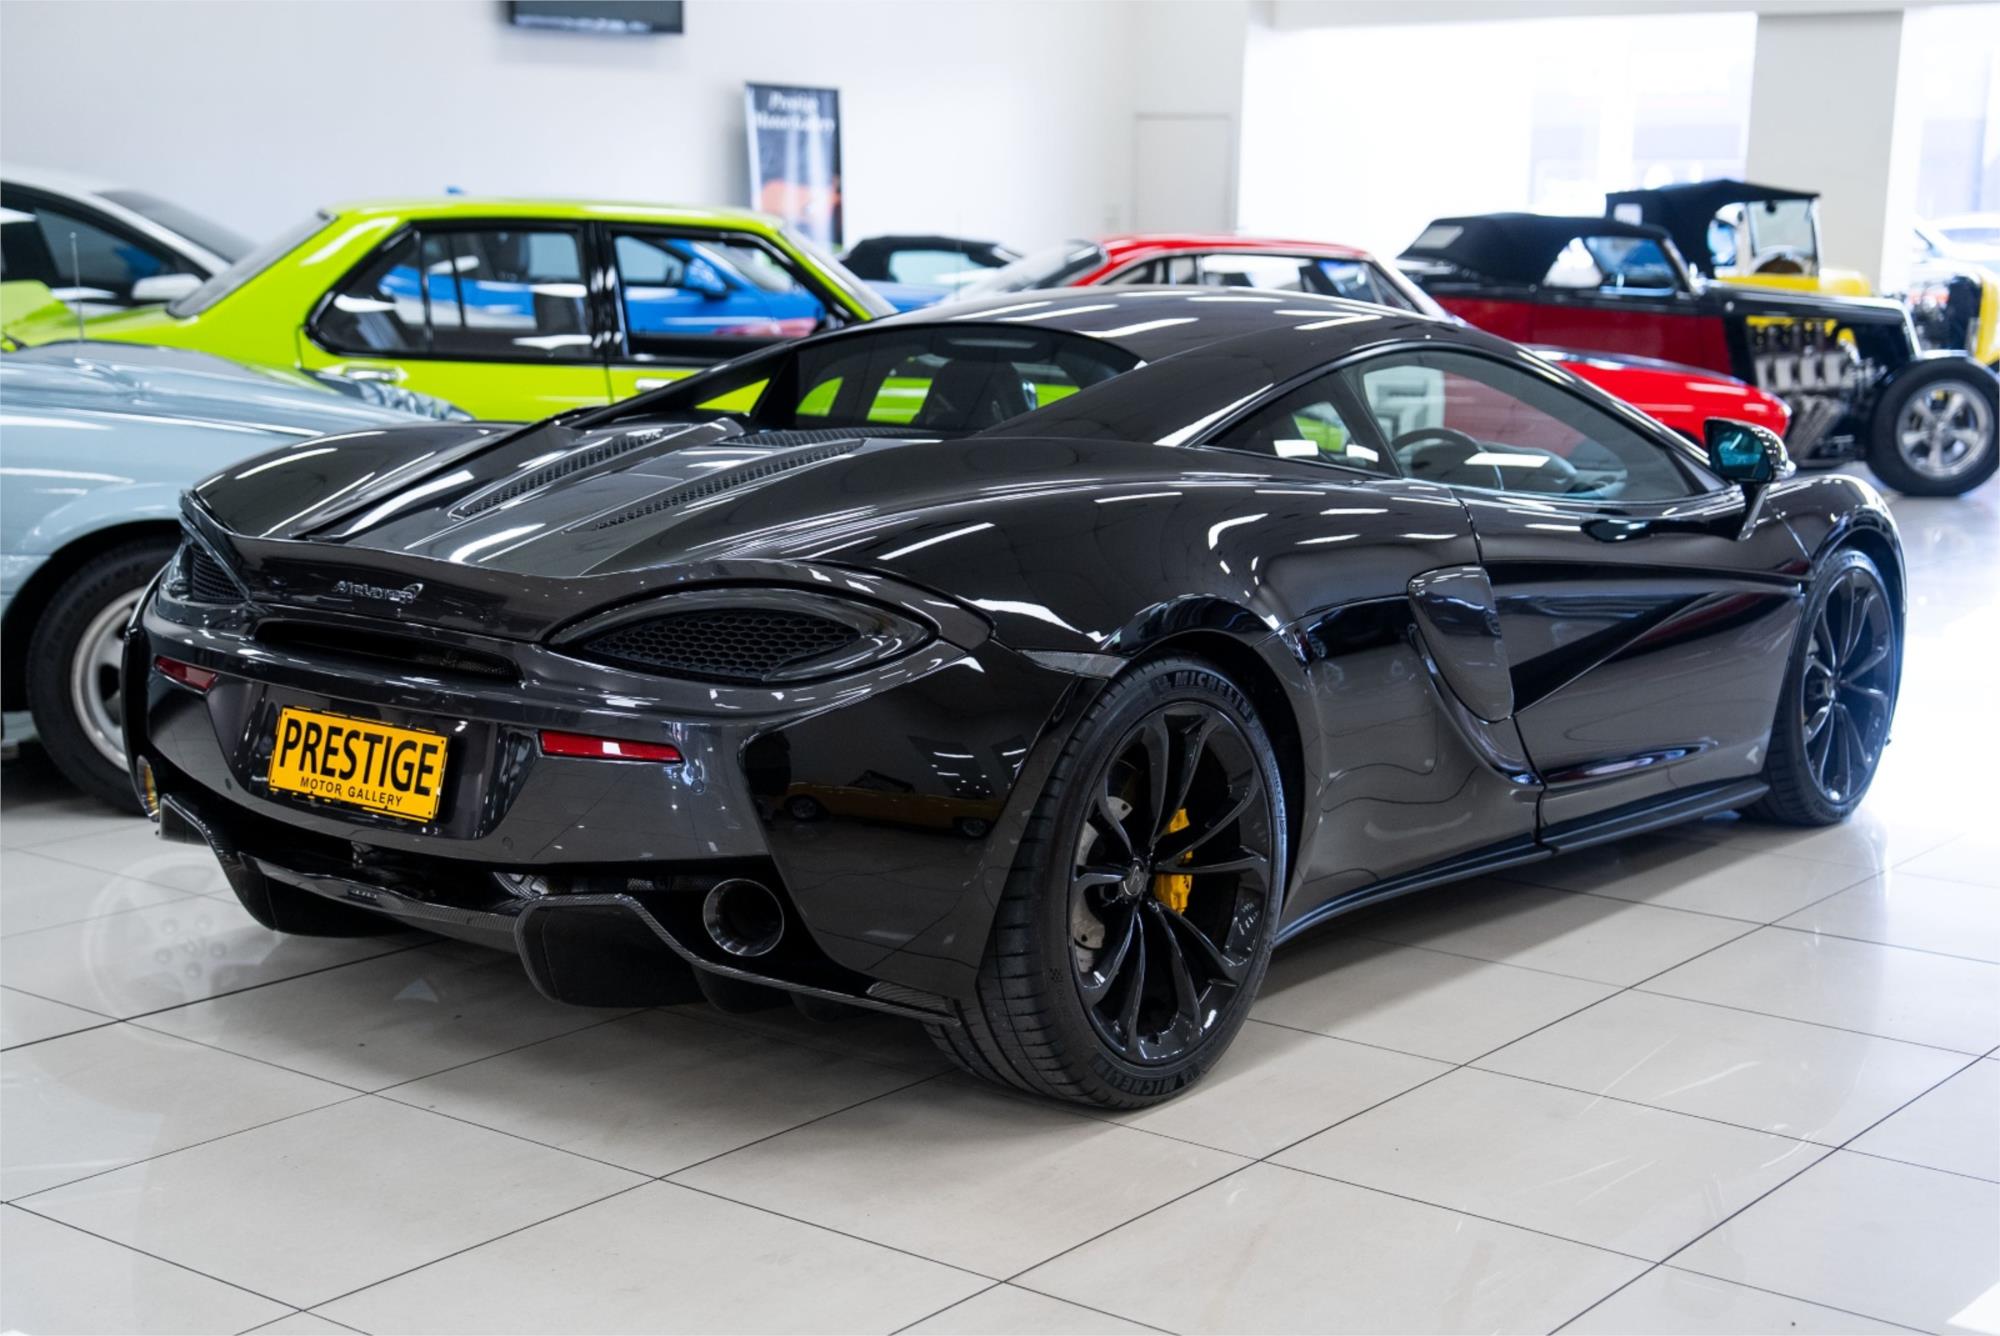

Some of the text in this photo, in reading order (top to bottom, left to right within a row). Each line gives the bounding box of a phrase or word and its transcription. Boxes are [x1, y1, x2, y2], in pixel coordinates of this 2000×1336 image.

[1175, 671, 1254, 722] MICHELIN
[279, 718, 439, 797] PRESTIGE
[300, 777, 403, 807] MOTOR GALLERY
